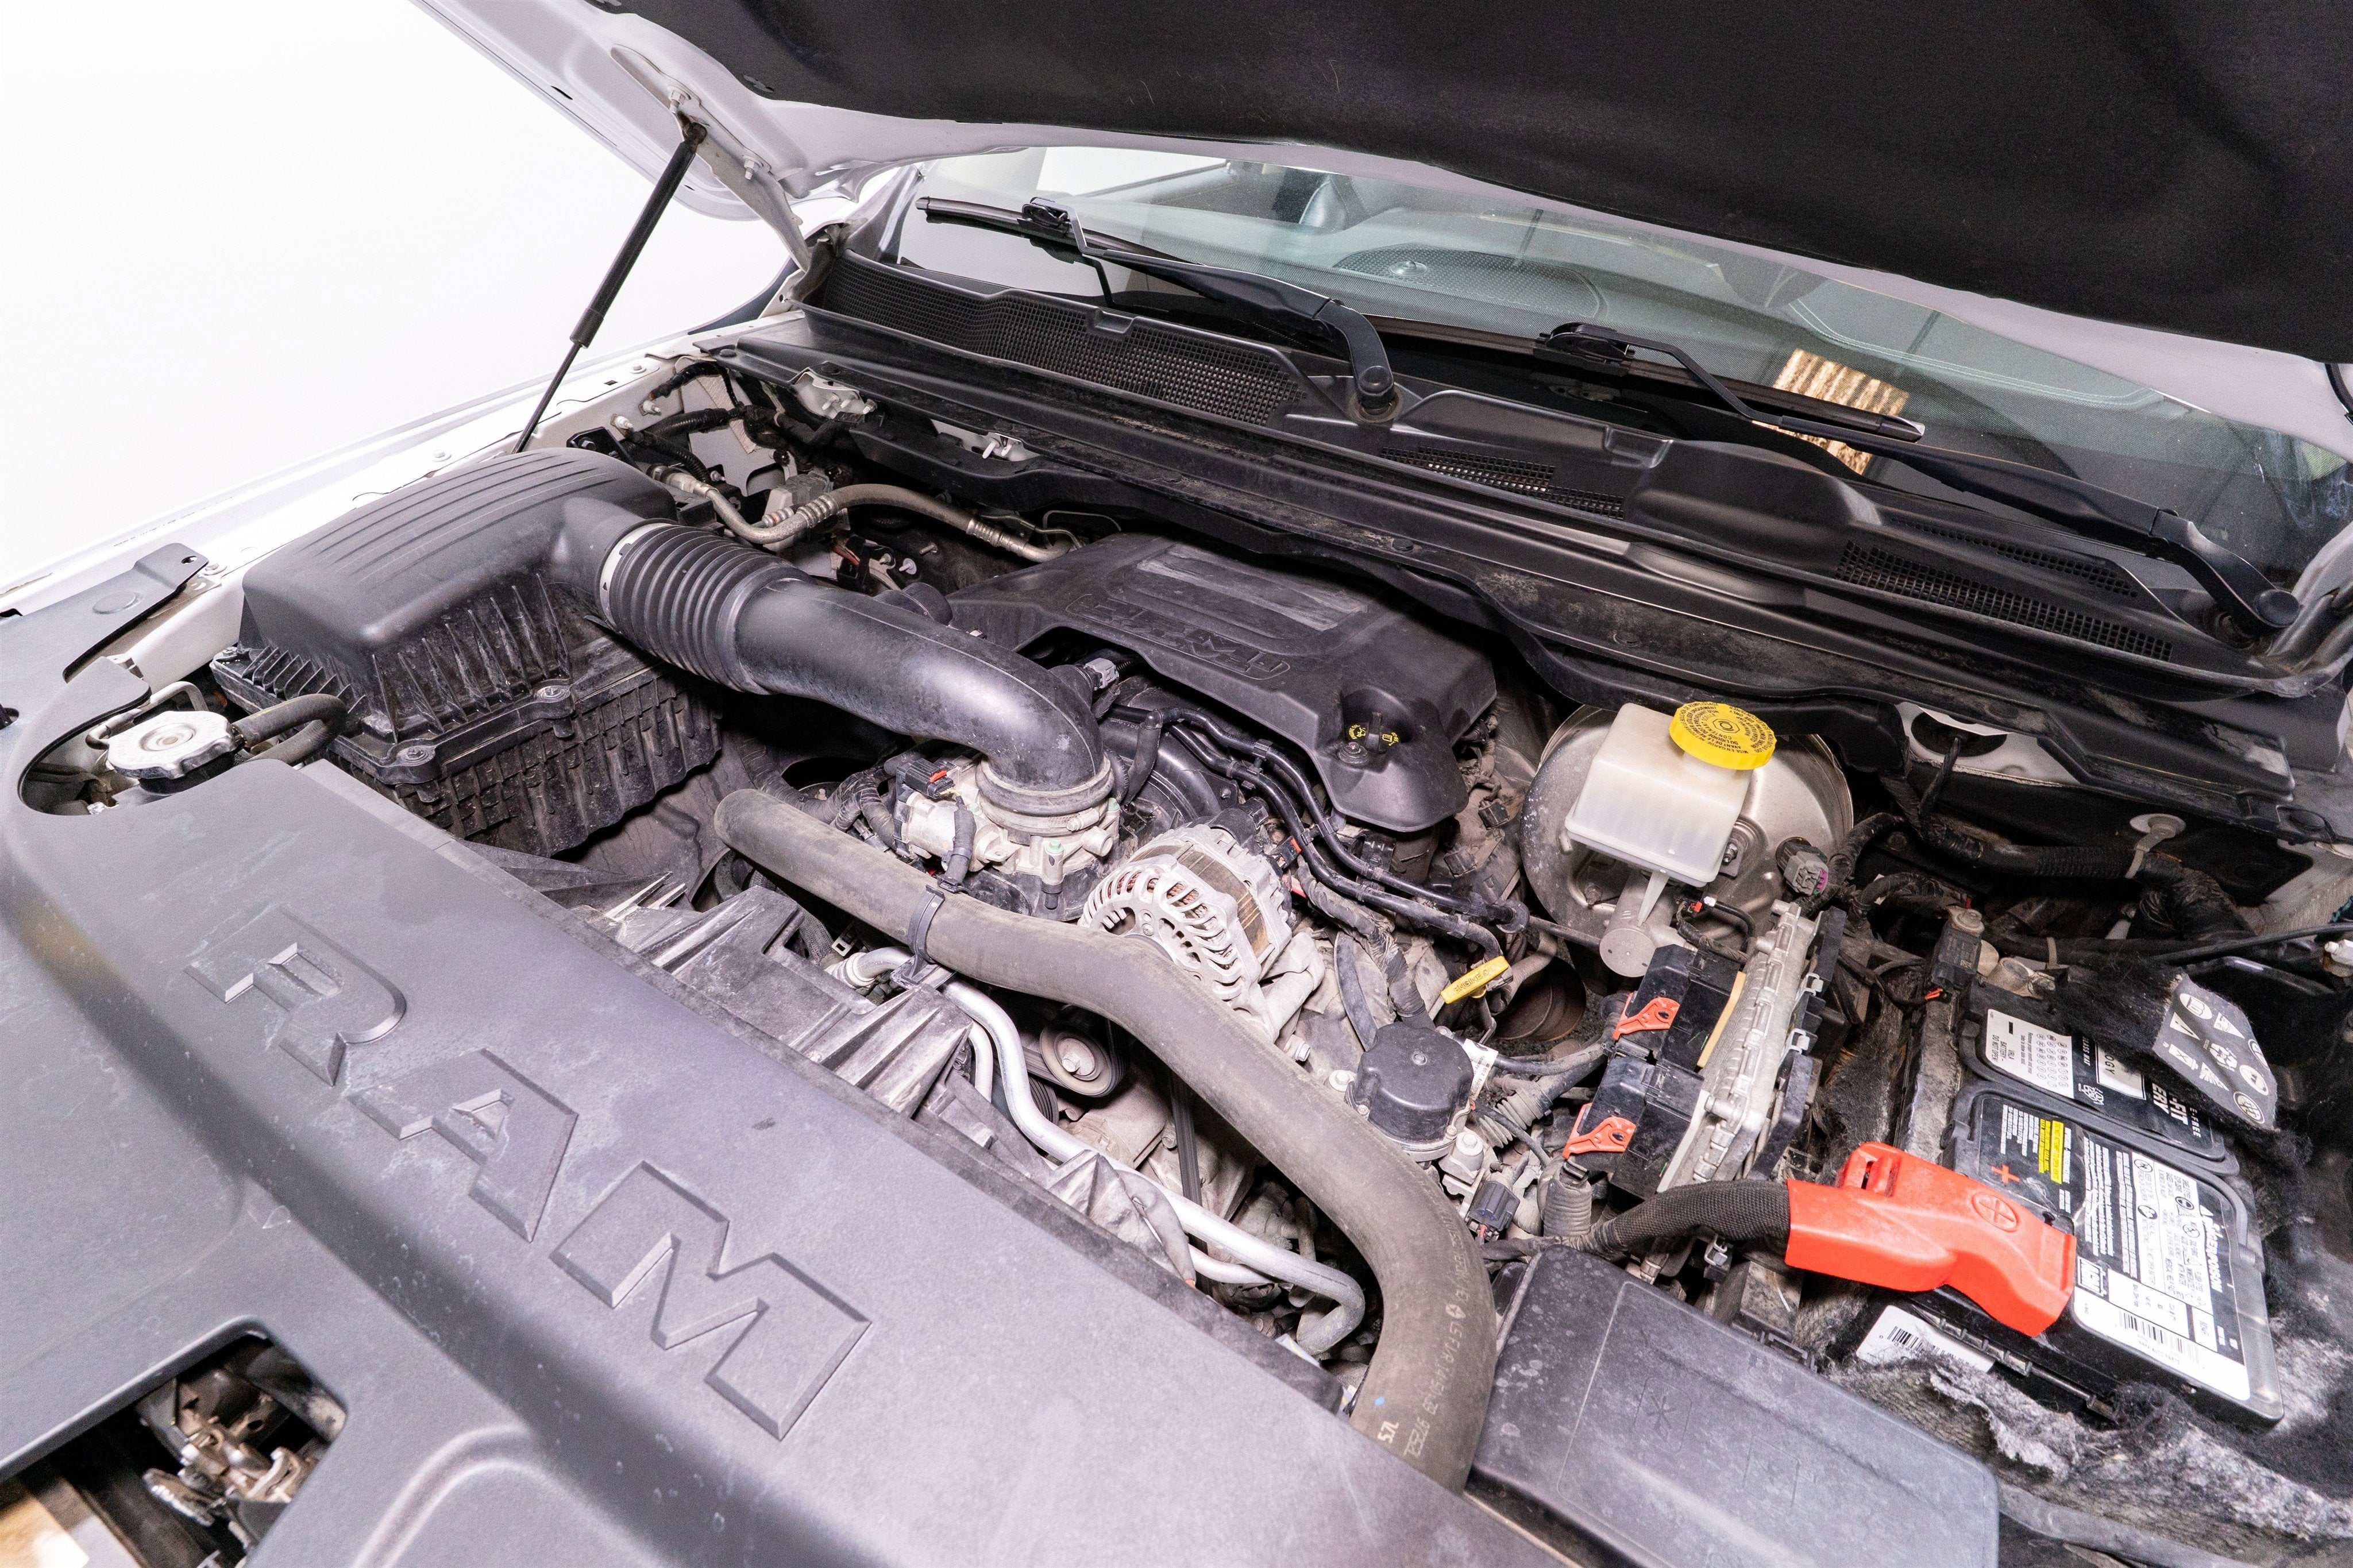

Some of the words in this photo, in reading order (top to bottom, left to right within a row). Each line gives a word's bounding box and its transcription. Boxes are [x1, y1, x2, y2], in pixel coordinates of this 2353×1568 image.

[1453, 972, 1483, 994] ENGINE
[2169, 1093, 2189, 1125] -FIT
[184, 904, 872, 1440] RAM
